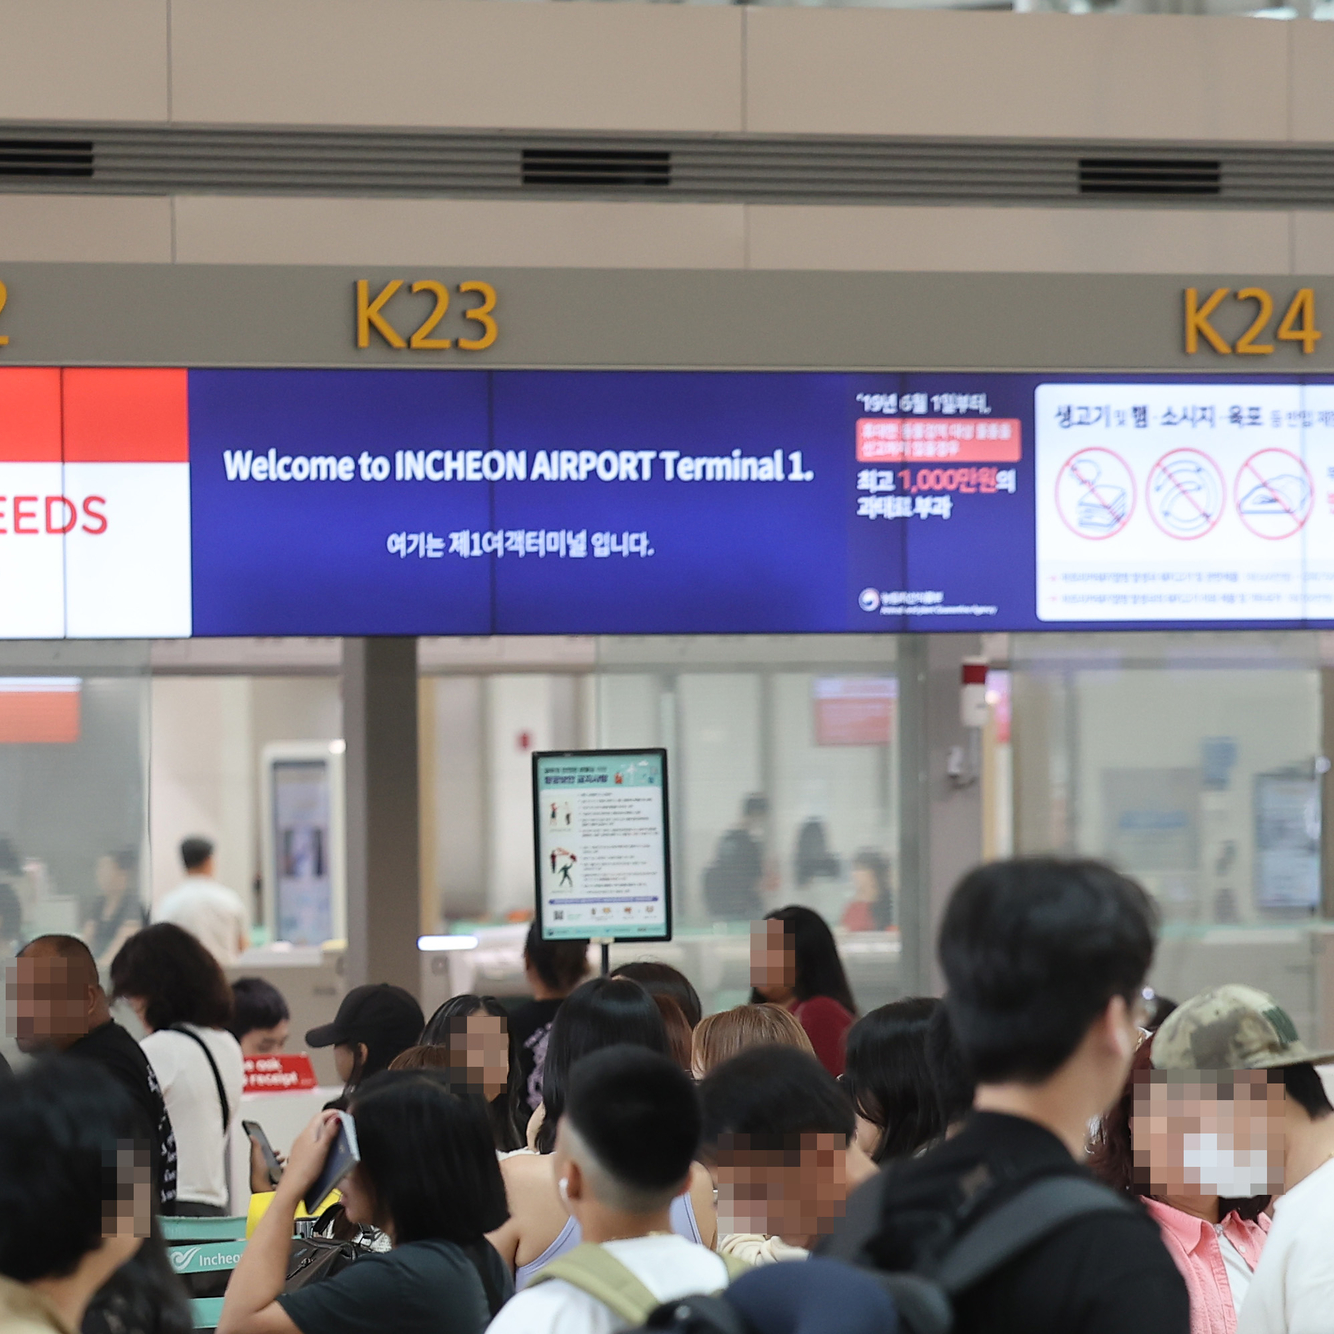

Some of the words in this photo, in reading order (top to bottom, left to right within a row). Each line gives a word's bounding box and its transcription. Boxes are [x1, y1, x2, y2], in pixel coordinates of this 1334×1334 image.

[354, 279, 499, 351] K23
[1183, 287, 1323, 355] K24
[1054, 404, 1110, 429] 생고기
[224, 449, 354, 482] Welcome
[358, 453, 390, 482] to
[394, 450, 527, 482] INCHEON
[530, 450, 656, 482] AIRPORT
[660, 449, 784, 482] Terminal
[787, 452, 814, 482] 1.
[857, 469, 896, 493] 최고
[386, 531, 445, 558] 여기는
[448, 529, 588, 558] 제1여객터미널
[591, 531, 654, 558] 입니다.
